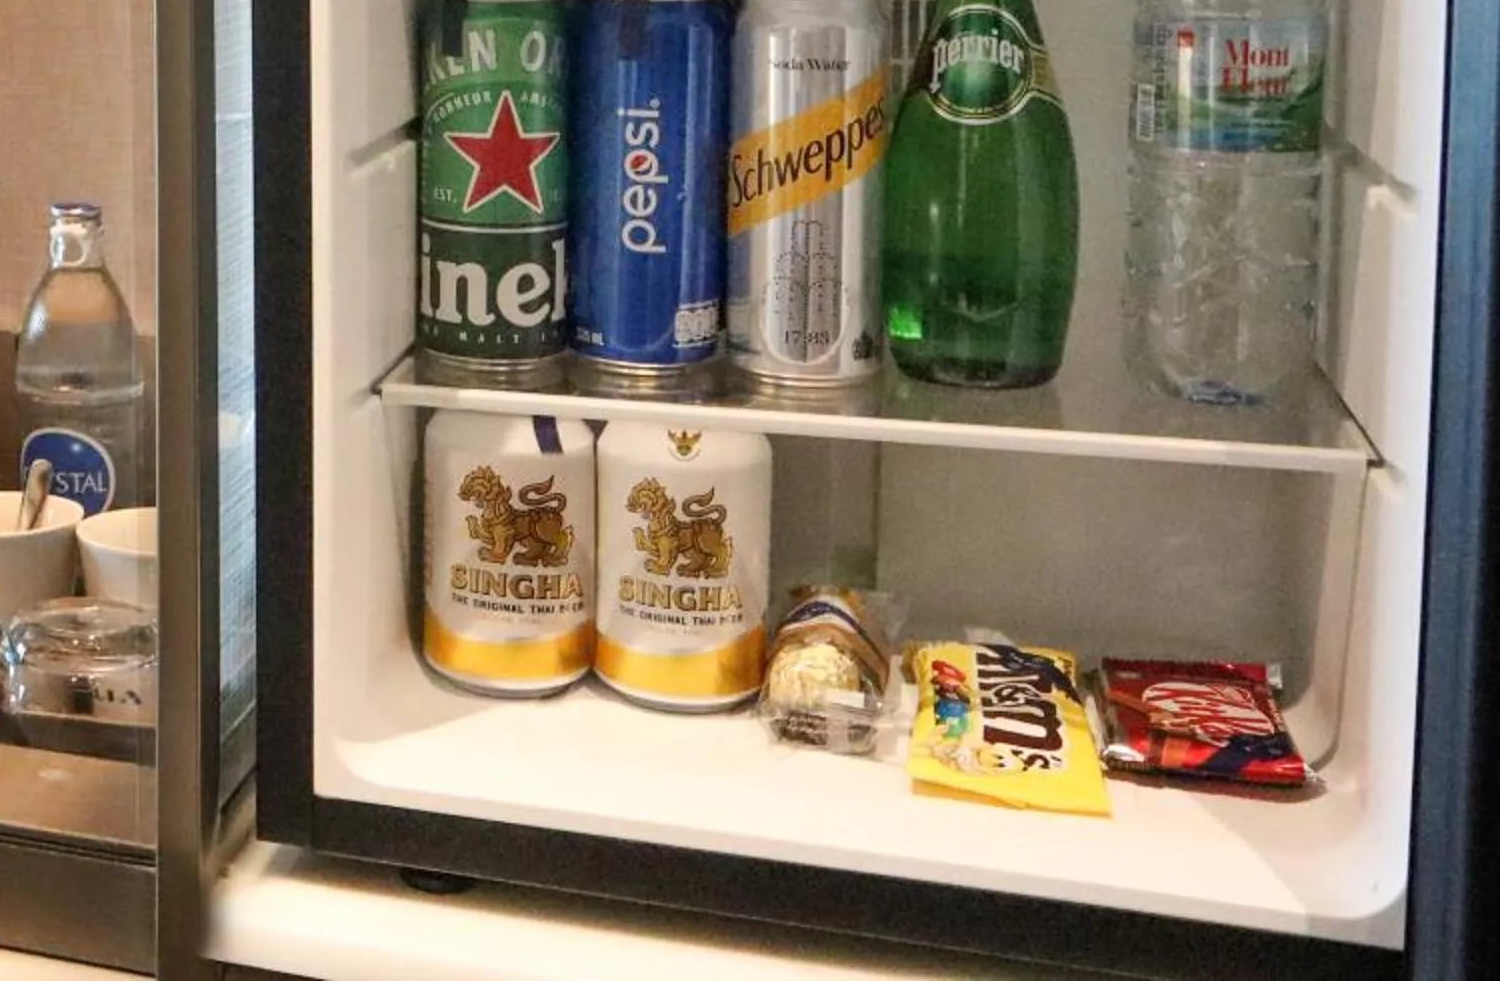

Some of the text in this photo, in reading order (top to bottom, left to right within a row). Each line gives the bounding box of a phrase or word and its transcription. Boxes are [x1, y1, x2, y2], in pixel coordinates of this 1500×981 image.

[806, 57, 851, 71] Water
[928, 27, 1025, 95] perrier
[450, 564, 584, 601] SINGHA
[619, 575, 743, 612] SINGHA
[450, 592, 469, 606] THE
[472, 598, 525, 614] ORIGINAL
[529, 603, 556, 615] THAI
[638, 610, 688, 626] ORIGINAL
